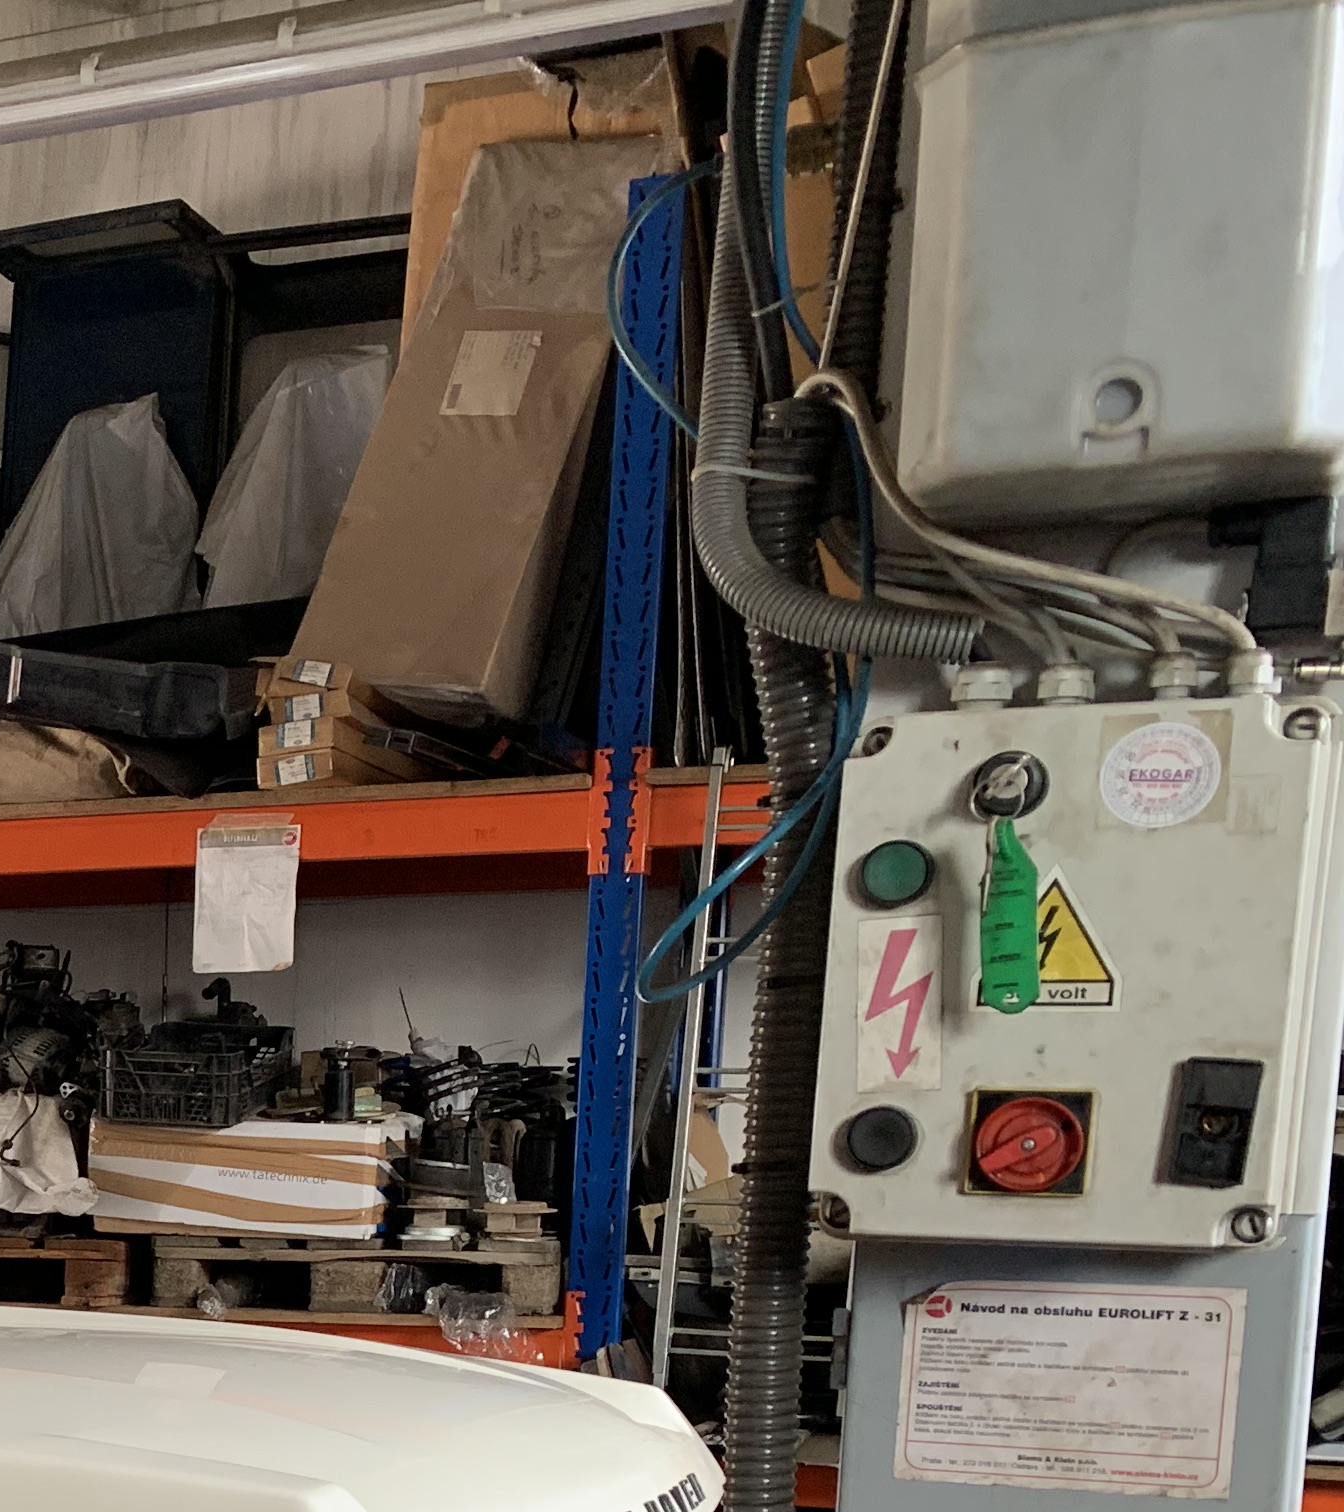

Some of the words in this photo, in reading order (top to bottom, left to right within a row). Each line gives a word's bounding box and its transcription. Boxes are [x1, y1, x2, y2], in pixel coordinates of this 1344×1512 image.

[1048, 987, 1088, 1000] volt
[960, 1302, 1006, 1314] Návod
[1010, 1305, 1029, 1315] na
[1034, 1305, 1093, 1318] obsluhu
[1098, 1307, 1175, 1321] EUROLIFT
[1178, 1310, 1190, 1321] Z
[1204, 1312, 1222, 1322] 31
